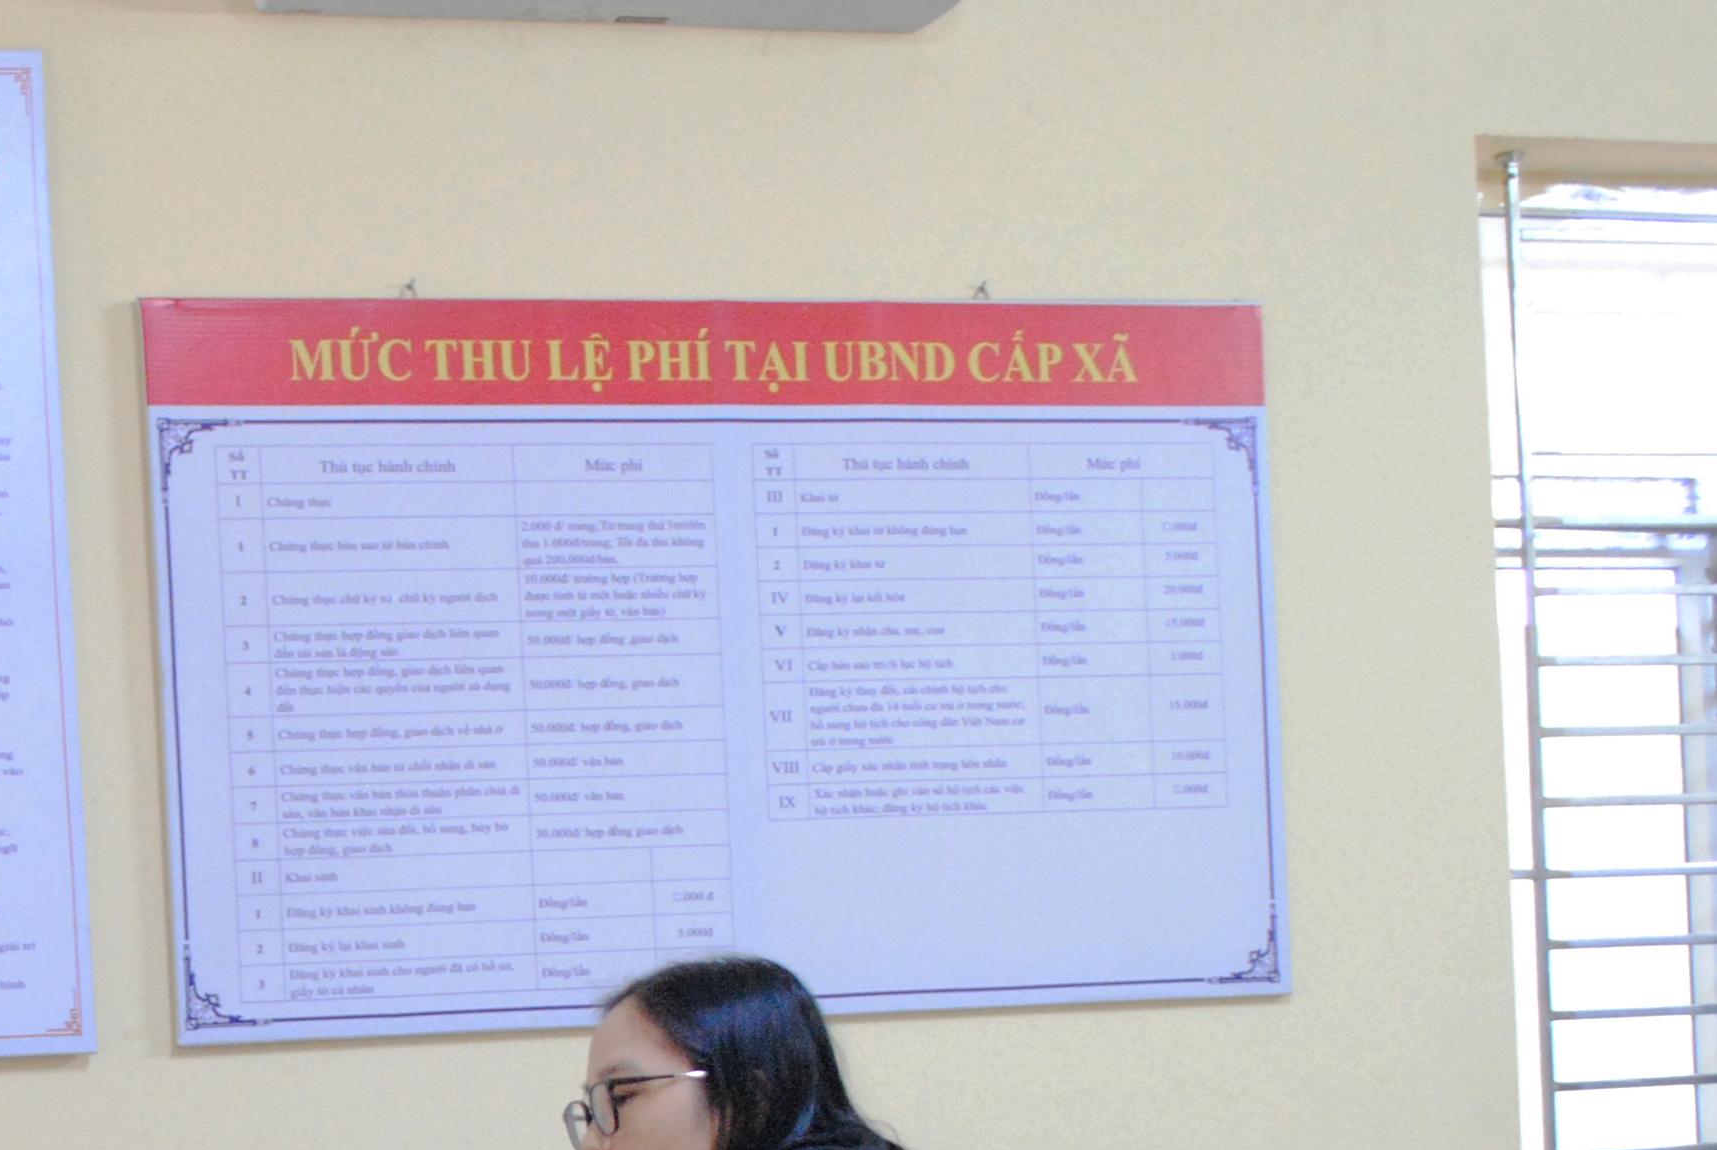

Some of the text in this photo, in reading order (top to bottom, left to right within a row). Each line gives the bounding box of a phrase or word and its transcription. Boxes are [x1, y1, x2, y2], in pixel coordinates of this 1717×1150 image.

[289, 326, 1138, 393] MỨC THU LỆ PHÍ TẠI UBND CẤP XÃ
